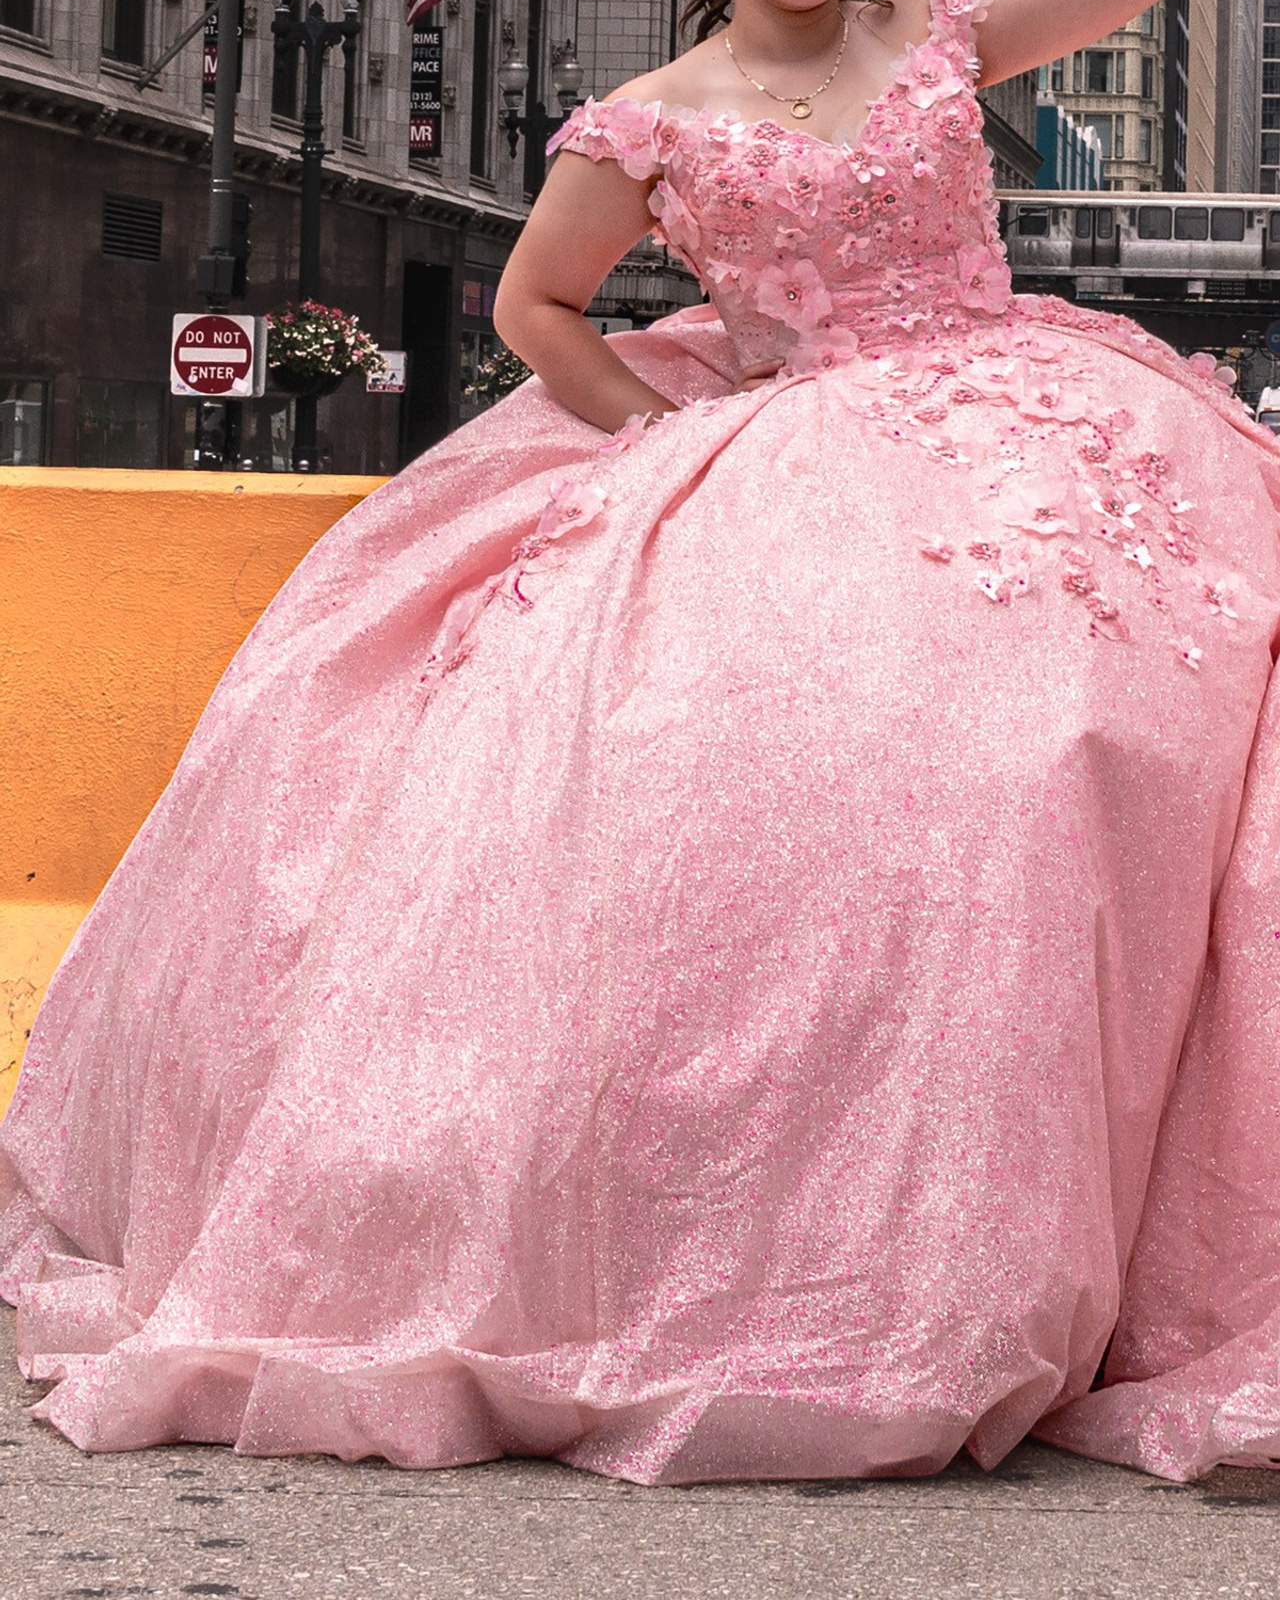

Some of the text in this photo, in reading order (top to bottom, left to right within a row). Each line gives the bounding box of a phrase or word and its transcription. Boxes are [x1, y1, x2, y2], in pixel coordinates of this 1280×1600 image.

[412, 33, 440, 45] RIME
[413, 47, 442, 58] FFICE
[412, 61, 440, 73] PACE
[410, 125, 433, 142] MR
[185, 330, 241, 345] DO NOT
[190, 366, 234, 379] ENTER
